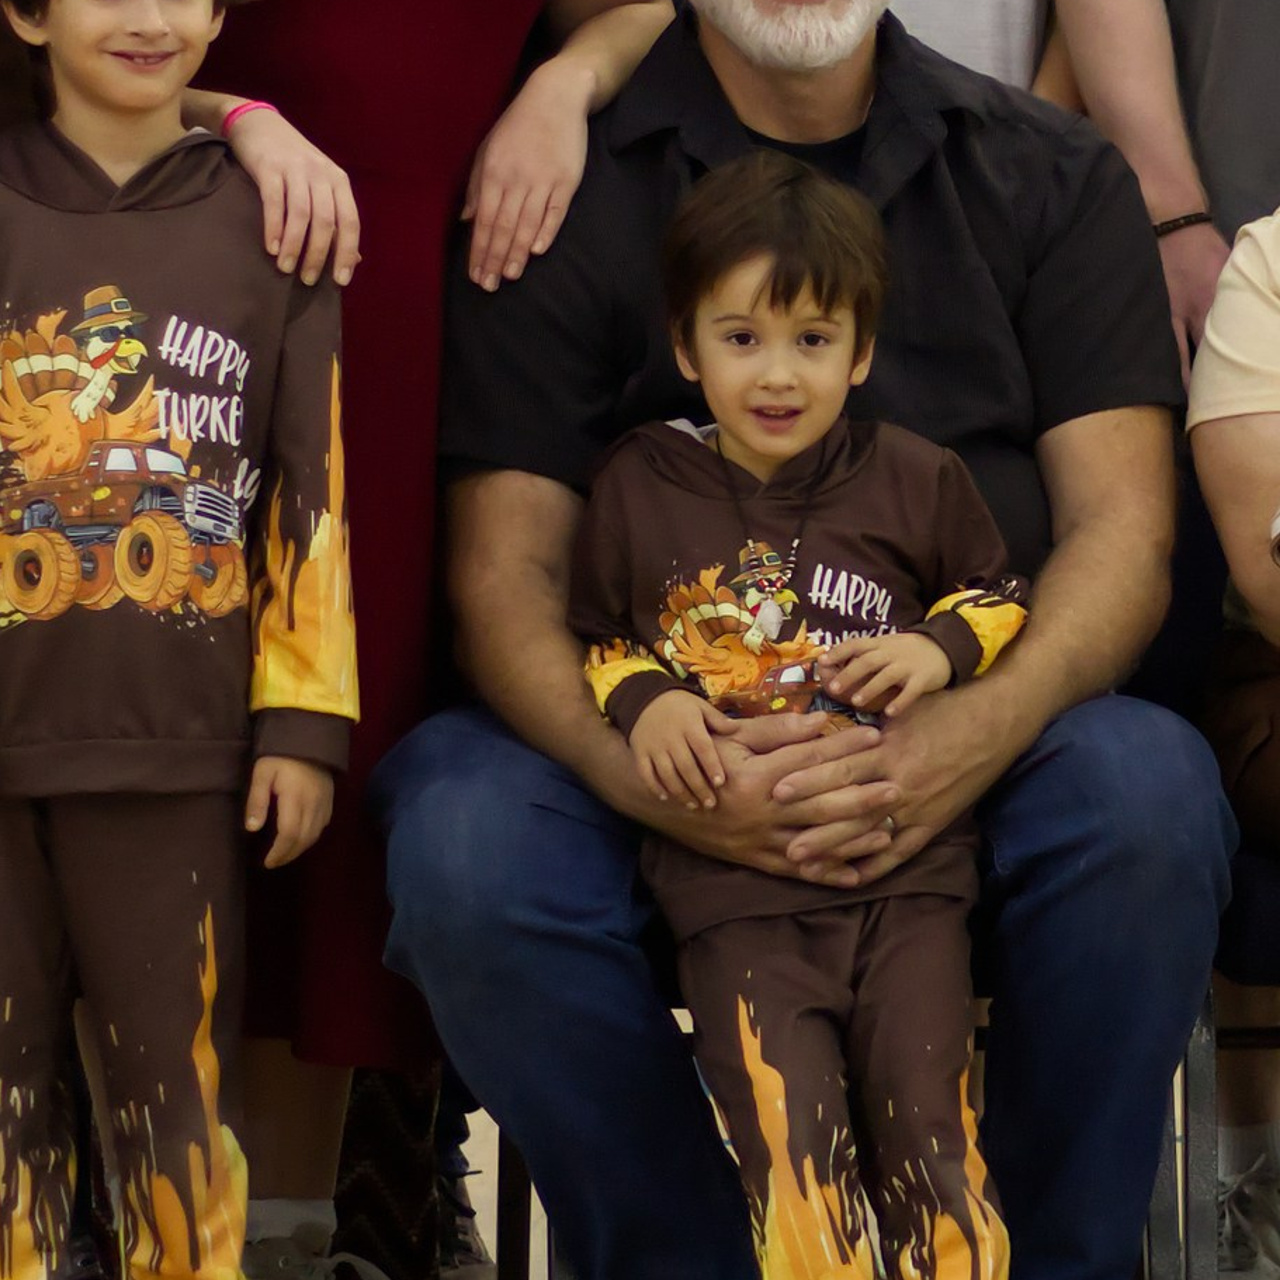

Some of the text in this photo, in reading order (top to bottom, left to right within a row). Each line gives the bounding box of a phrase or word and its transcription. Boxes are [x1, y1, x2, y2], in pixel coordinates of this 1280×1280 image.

[158, 315, 250, 392] HAPPY
[153, 389, 244, 447] TURKE
[807, 563, 892, 622] HAPPY
